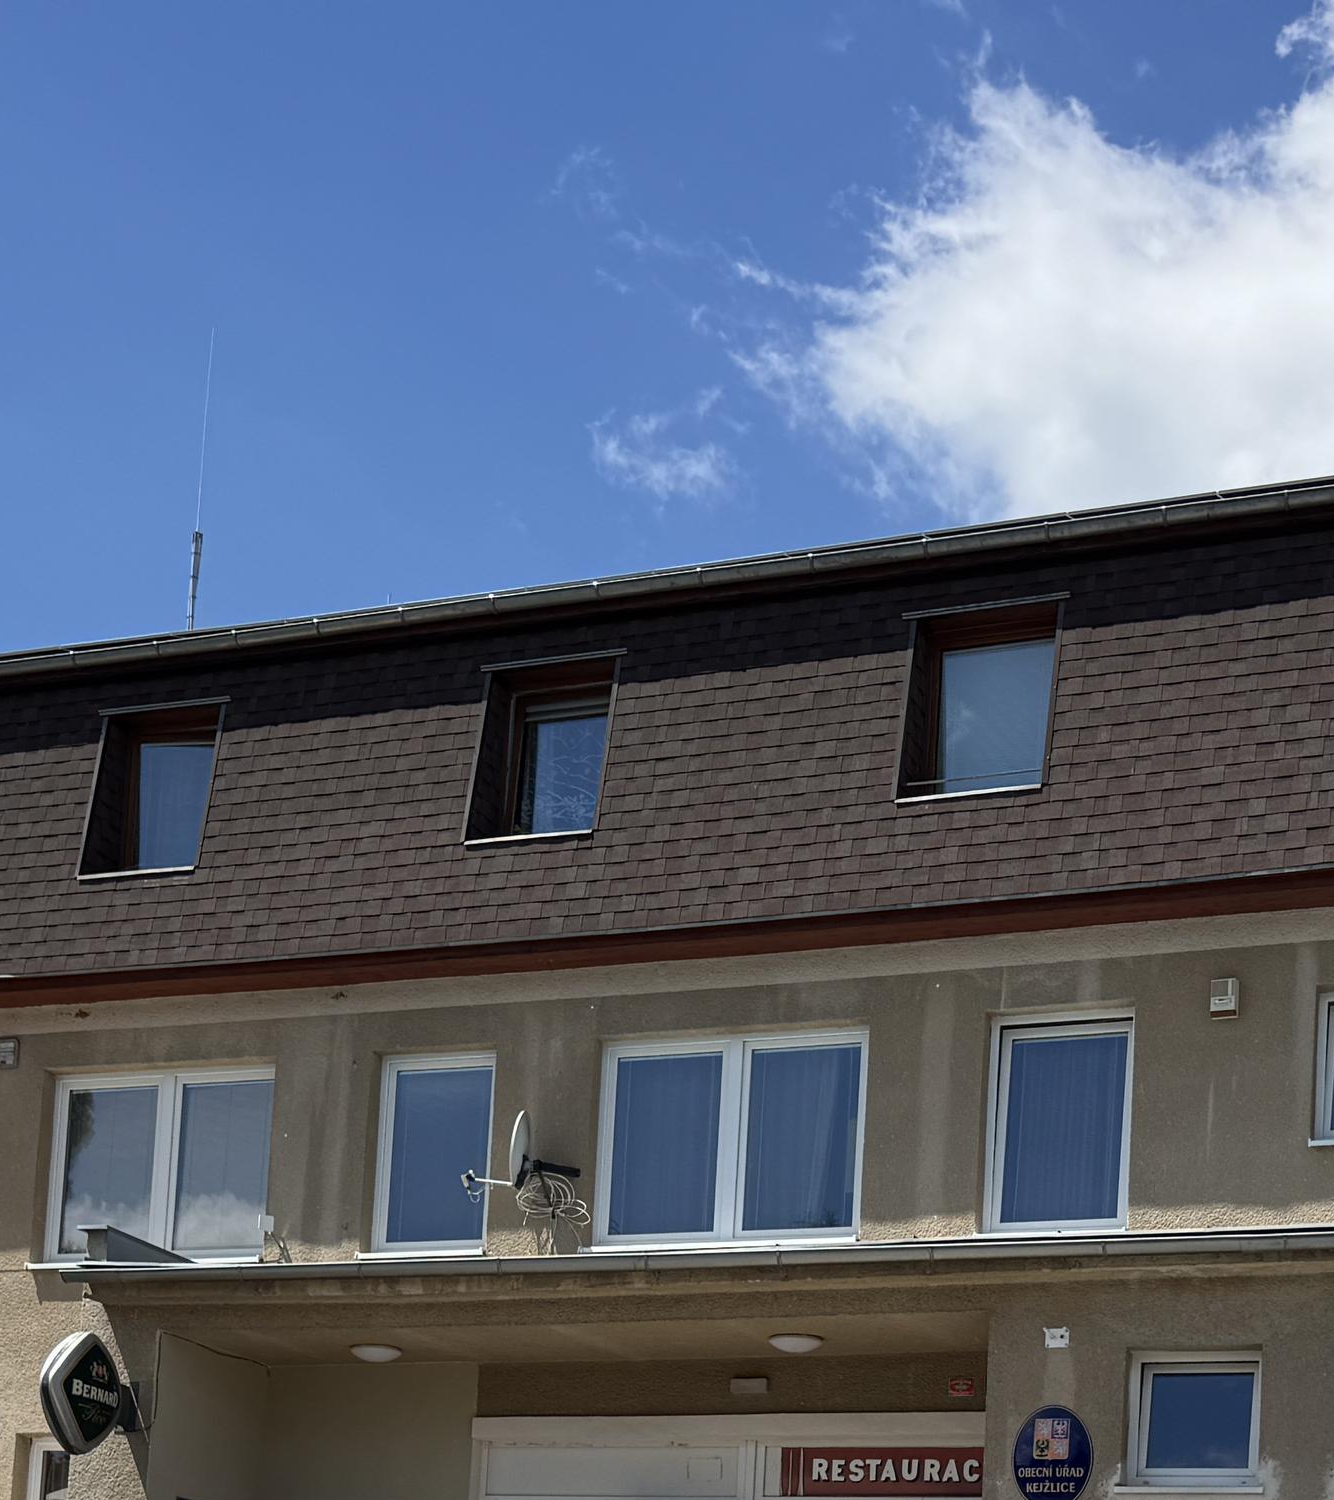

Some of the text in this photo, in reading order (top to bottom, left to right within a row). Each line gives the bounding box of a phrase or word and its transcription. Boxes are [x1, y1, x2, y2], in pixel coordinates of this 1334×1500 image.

[71, 1378, 119, 1408] BERNARD
[1018, 1464, 1084, 1478] OBECNÍ ÚŘAD
[1026, 1479, 1076, 1493] KEJŽLICE
